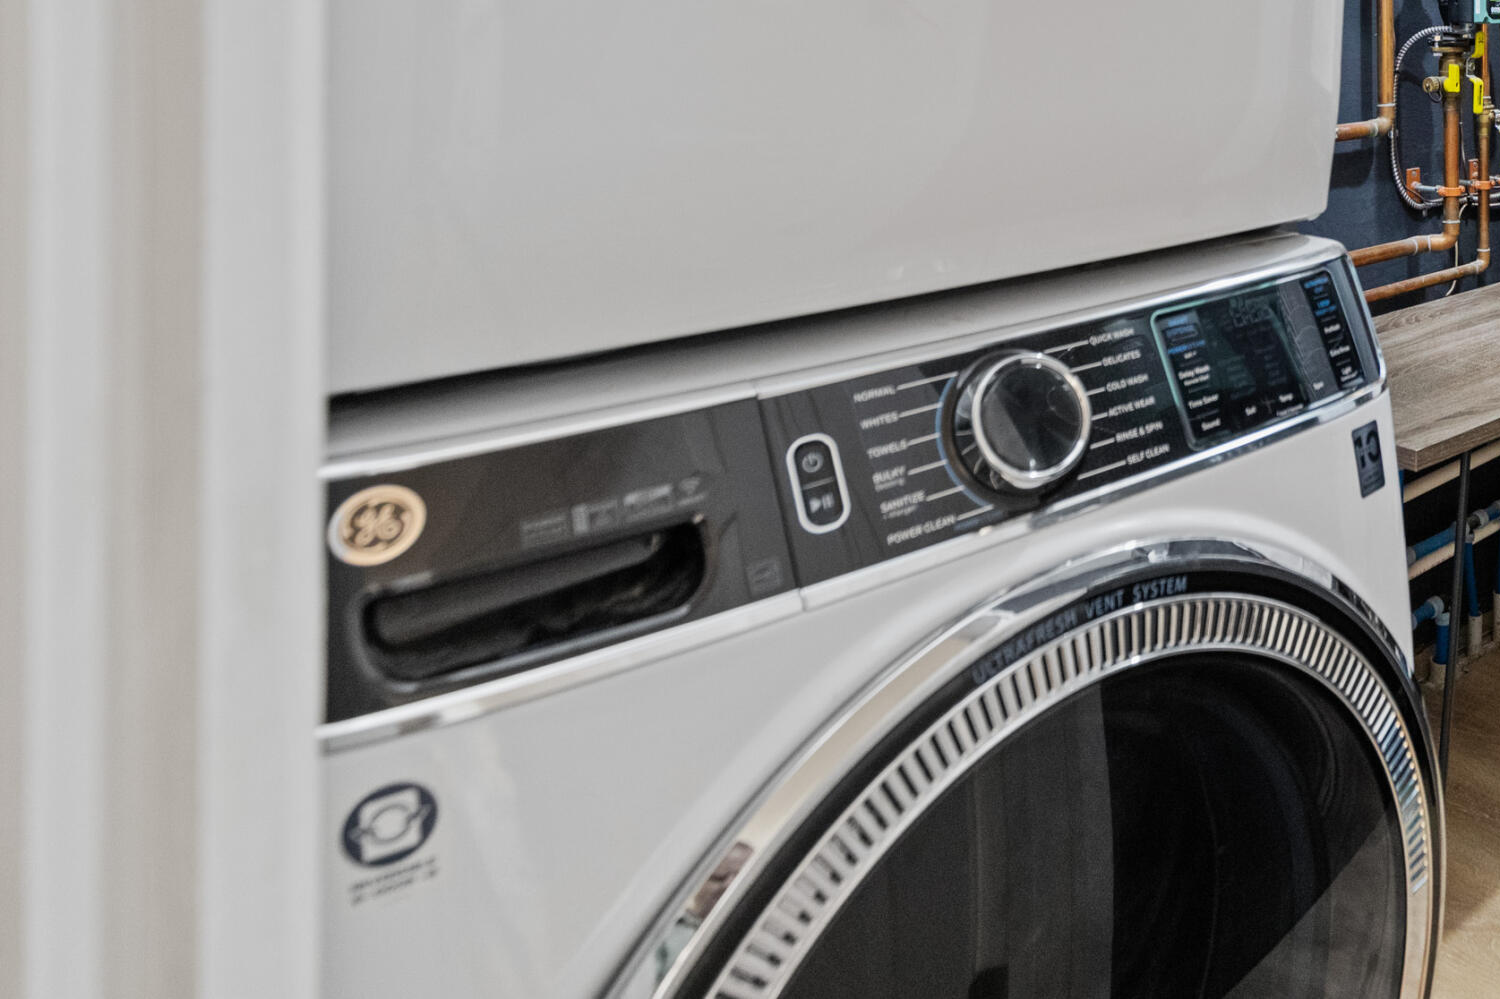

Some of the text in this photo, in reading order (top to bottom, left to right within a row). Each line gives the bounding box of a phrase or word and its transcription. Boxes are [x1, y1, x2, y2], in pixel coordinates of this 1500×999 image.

[1102, 350, 1141, 367] DELICATES
[853, 385, 896, 403] NORMAL
[1108, 396, 1155, 417] ACTIVE WEAR
[860, 411, 899, 430] WHITES
[867, 439, 908, 459] TOWELS
[1127, 444, 1170, 465] SELF CLEAN
[880, 490, 926, 513] SANITIZE
[887, 514, 957, 546] POWER CLEAN
[1086, 589, 1125, 618] VENT
[1132, 575, 1188, 602] SYSTEM
